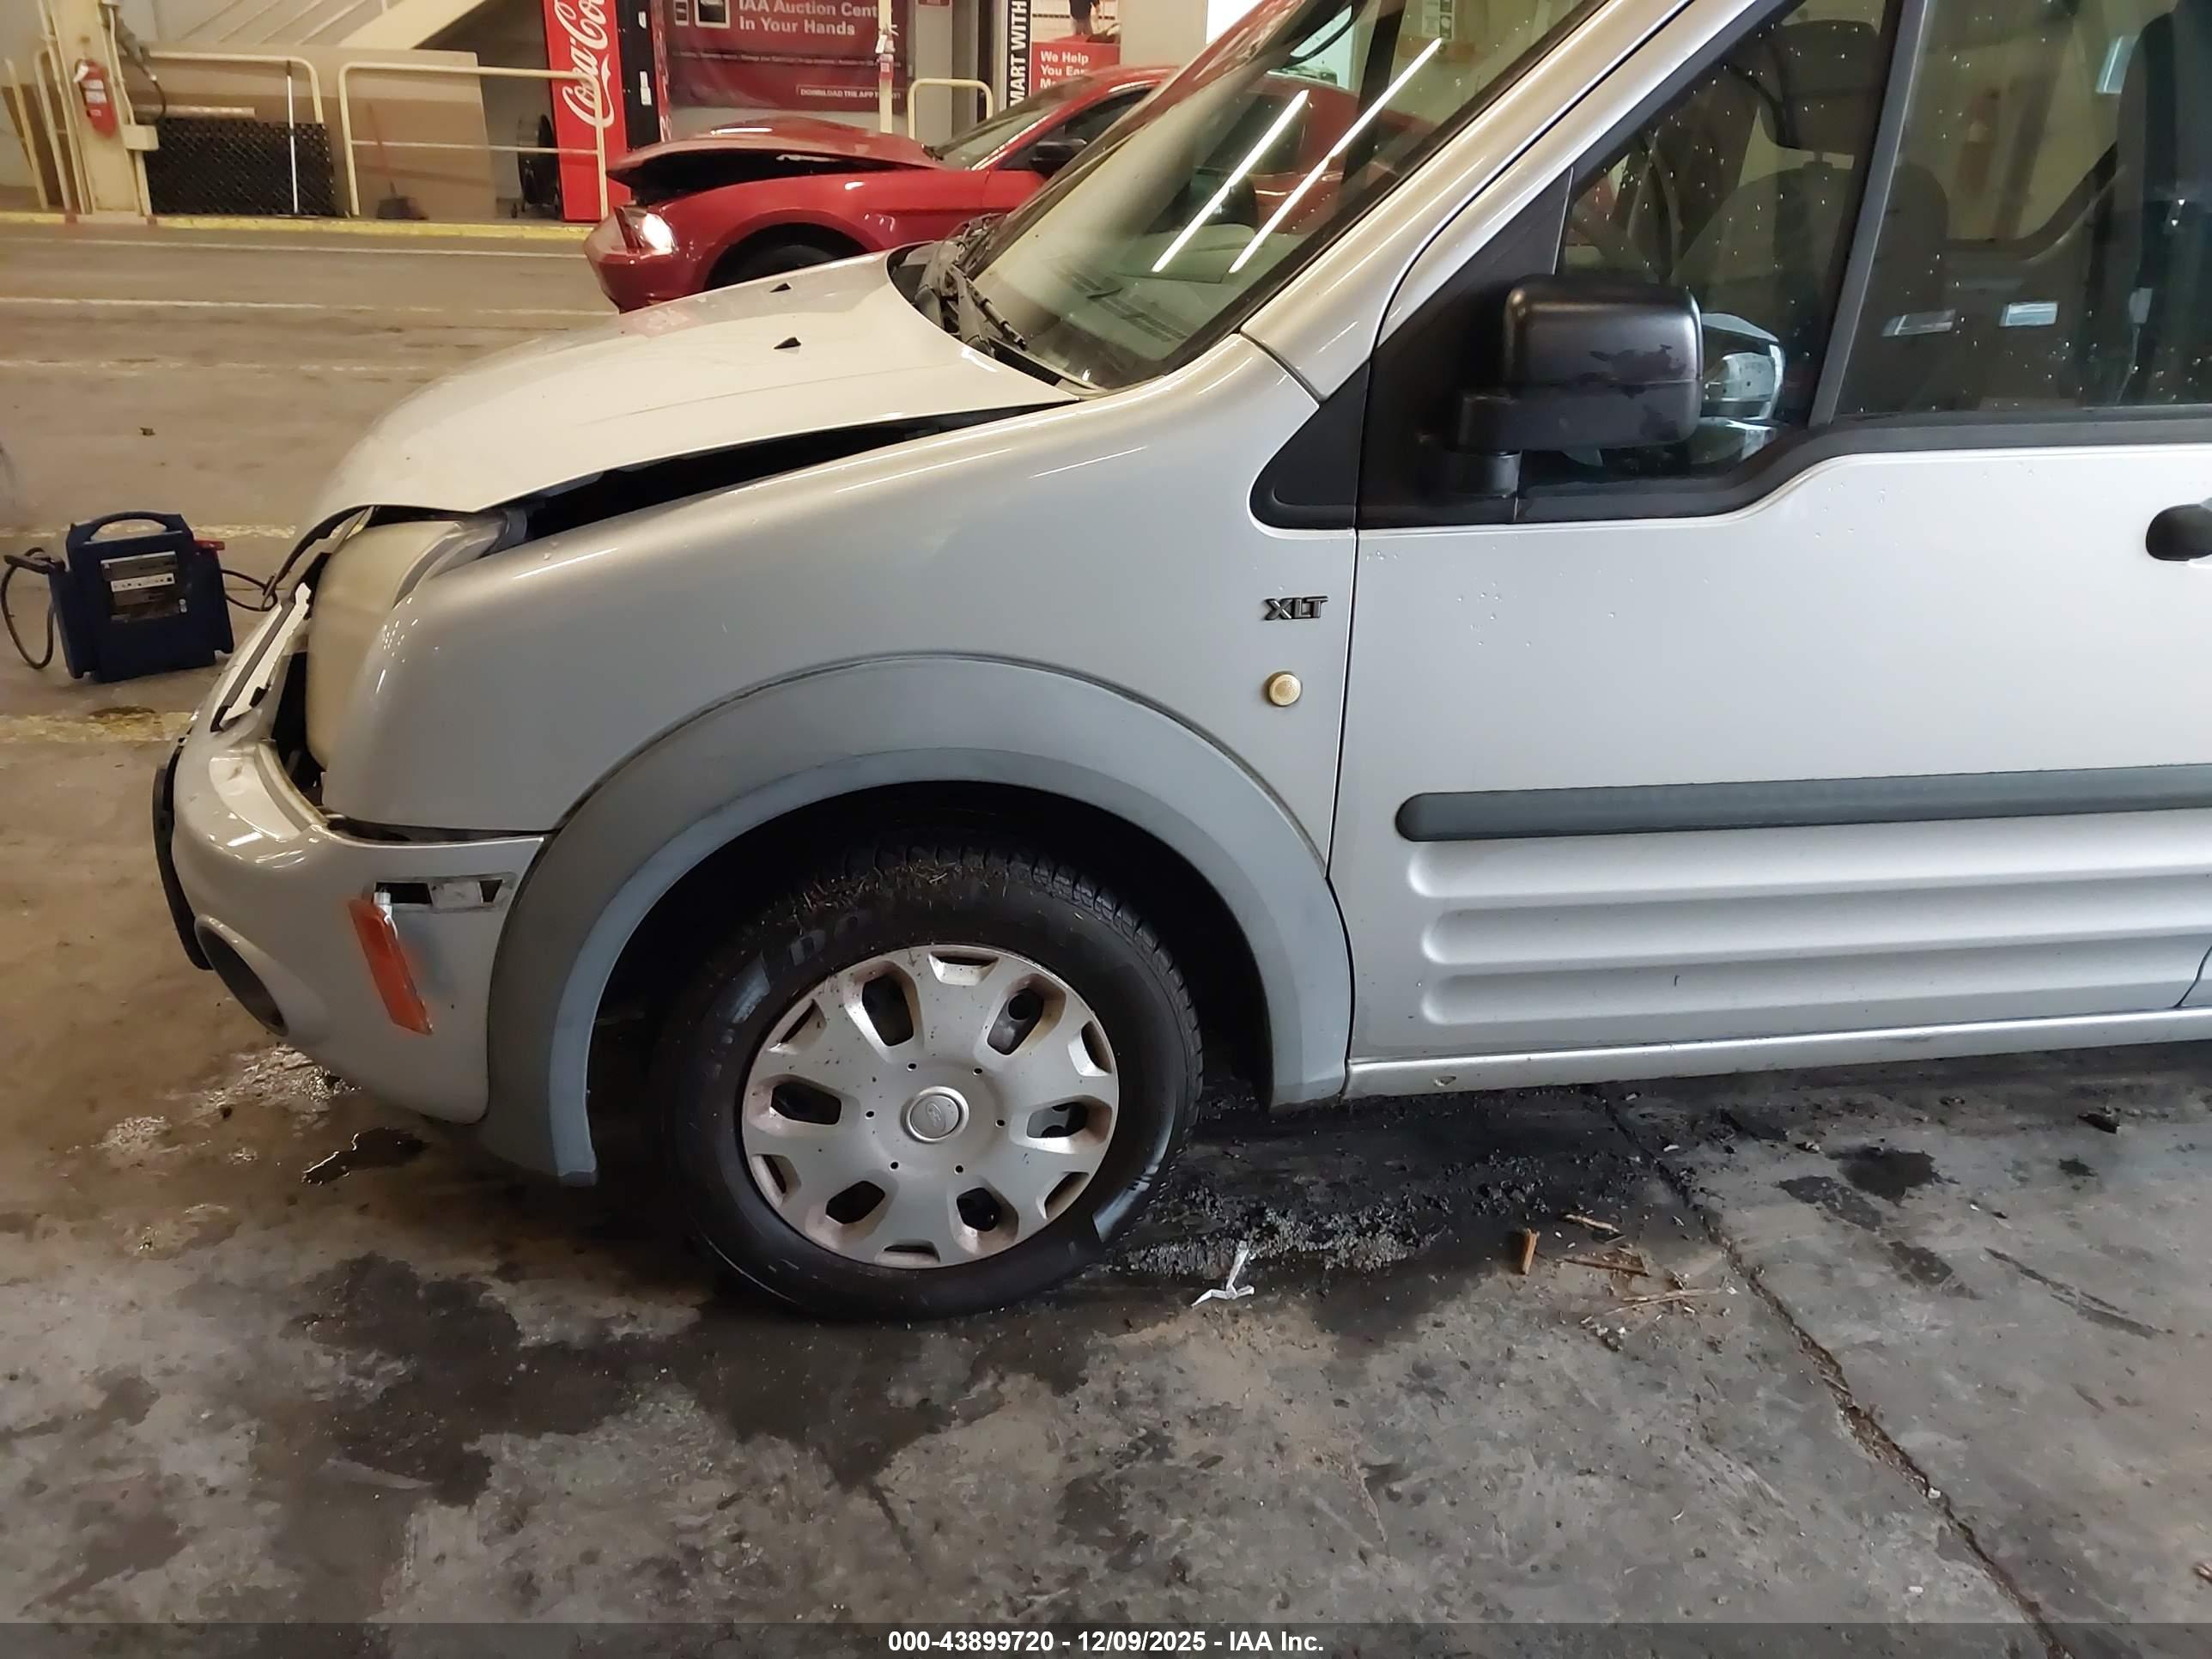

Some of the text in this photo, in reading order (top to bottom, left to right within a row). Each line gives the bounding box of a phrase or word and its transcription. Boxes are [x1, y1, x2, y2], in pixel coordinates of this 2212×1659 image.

[738, 0, 879, 18] IAA Auction Cent
[738, 15, 856, 35] In Your Hands
[1009, 0, 1028, 107] MART WITH
[1040, 50, 1089, 65] We Help
[554, 0, 615, 128] Coca-Co
[1040, 64, 1062, 76] You
[1263, 596, 1329, 621] XLT
